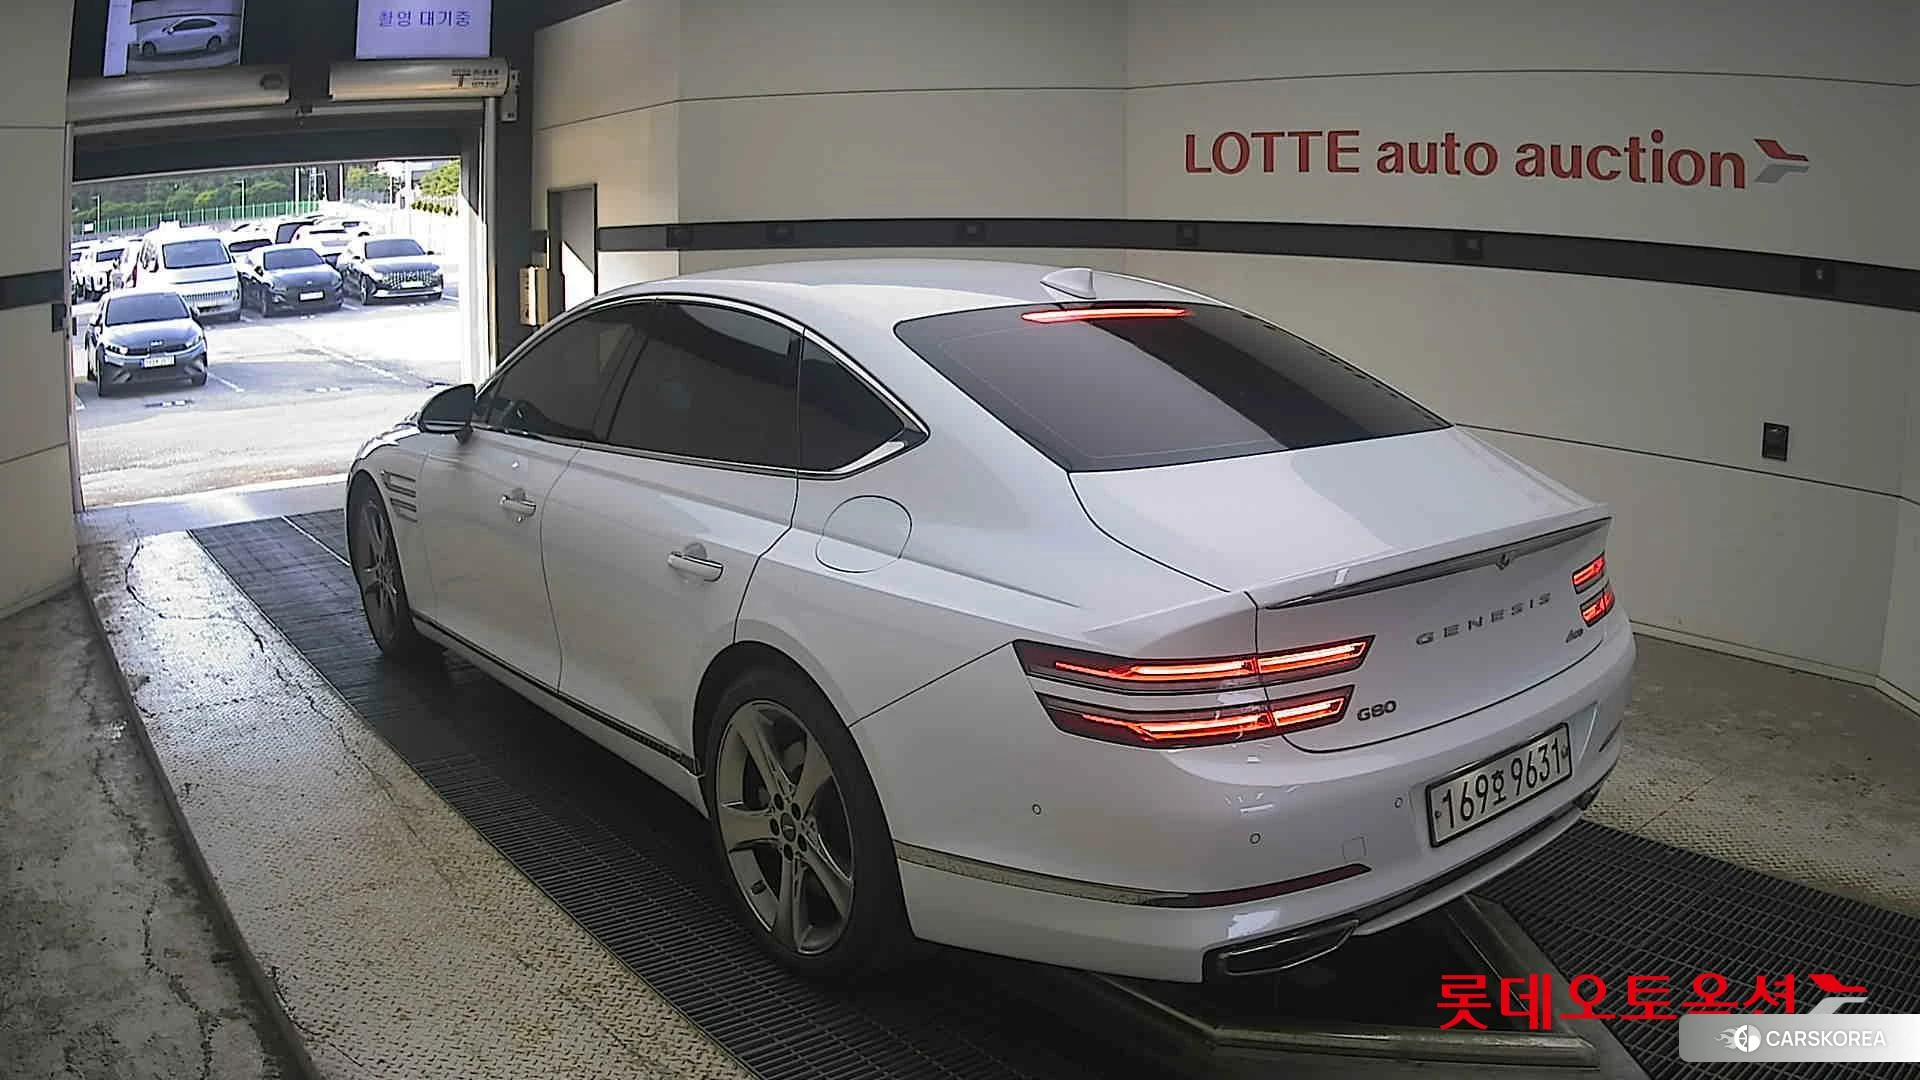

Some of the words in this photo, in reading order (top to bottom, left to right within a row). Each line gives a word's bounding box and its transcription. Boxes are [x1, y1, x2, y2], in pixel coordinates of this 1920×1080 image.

[419, 10, 472, 27] 대기중
[1185, 130, 1360, 175] LOTTE
[1376, 132, 1498, 176] auto
[1514, 128, 1746, 189] auction
[1415, 593, 1552, 646] GENESIS
[1356, 699, 1398, 722] G80
